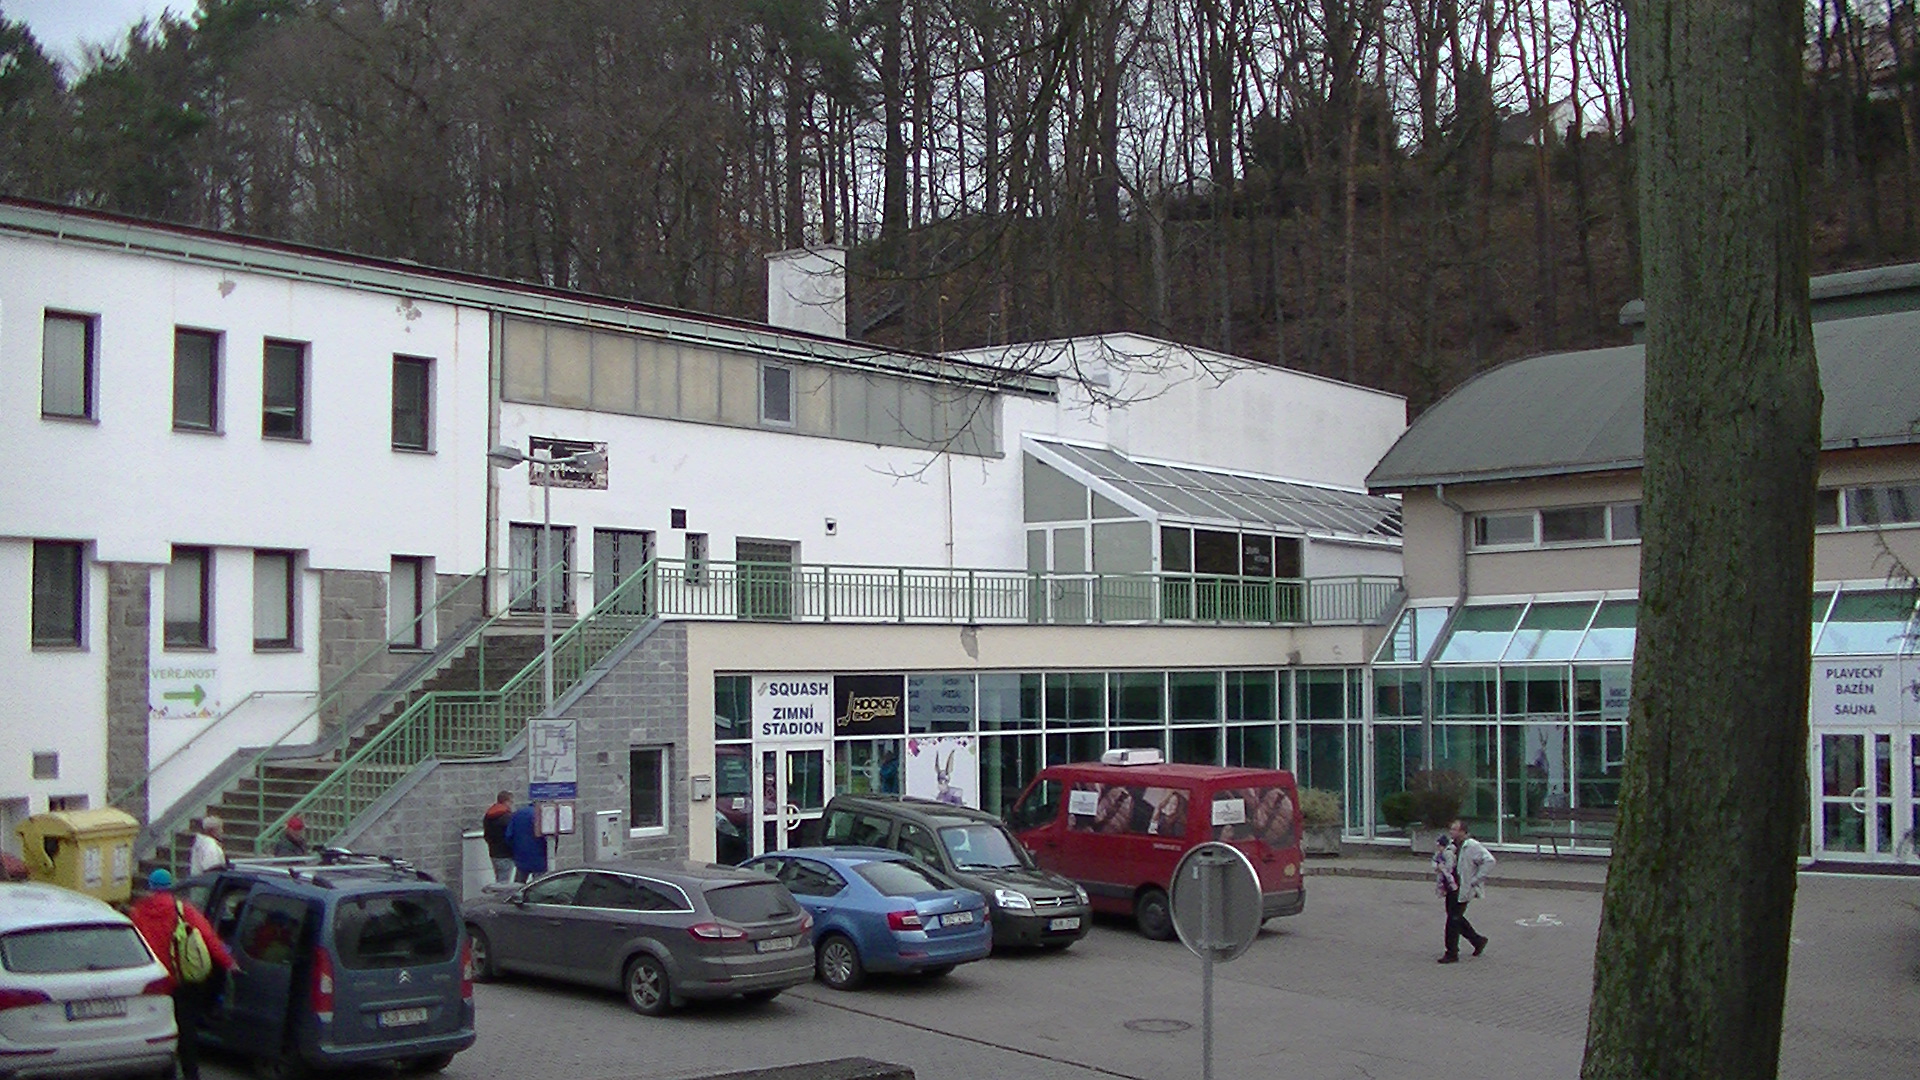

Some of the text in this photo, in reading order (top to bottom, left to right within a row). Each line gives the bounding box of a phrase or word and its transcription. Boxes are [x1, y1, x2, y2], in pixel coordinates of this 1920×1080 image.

[151, 667, 216, 679] VEŘEJNOST
[1826, 665, 1883, 678] PLAVECKÝ
[769, 682, 829, 696] SQUASH
[1835, 681, 1874, 695] BAZÉN
[853, 697, 899, 710] HOCKEY
[1834, 704, 1877, 715] SAUNA
[773, 704, 814, 720] ZIMNÍ
[762, 721, 824, 735] STADION
